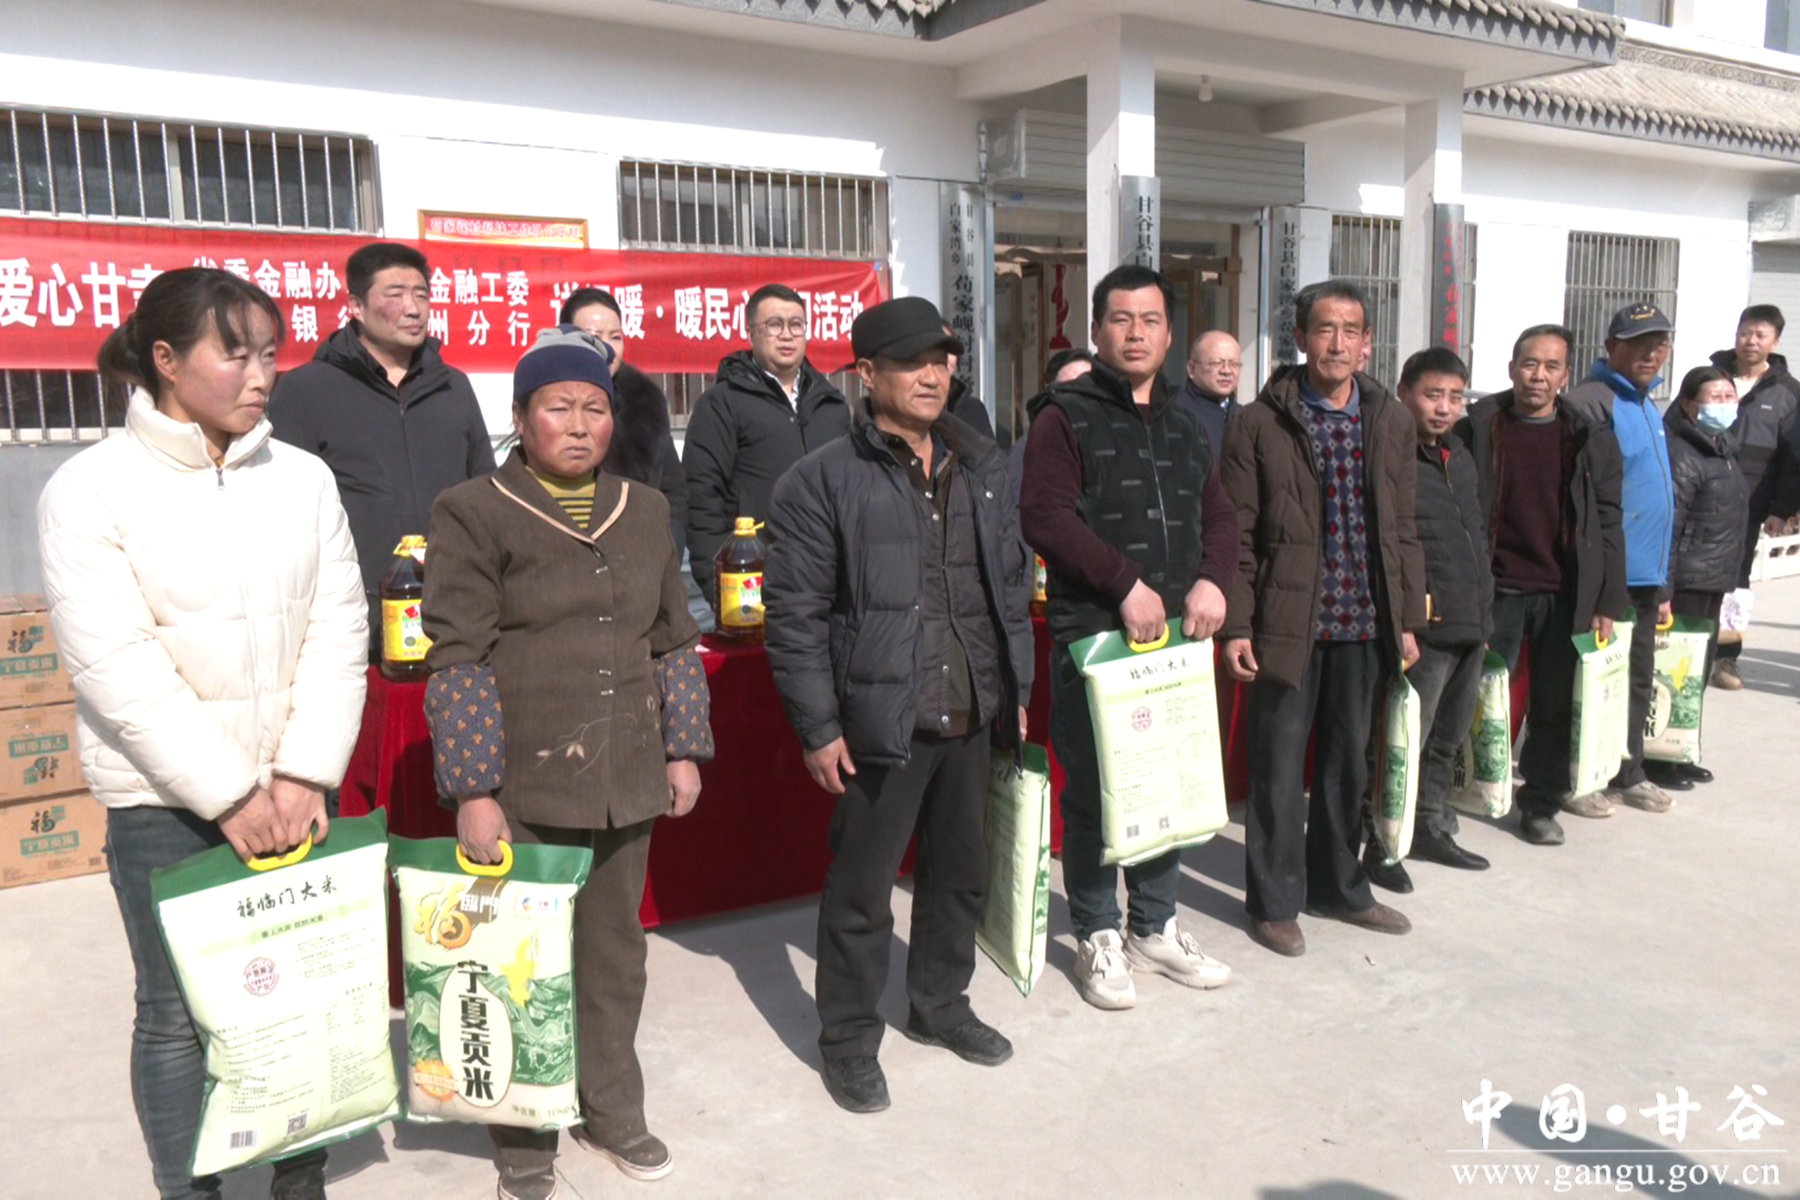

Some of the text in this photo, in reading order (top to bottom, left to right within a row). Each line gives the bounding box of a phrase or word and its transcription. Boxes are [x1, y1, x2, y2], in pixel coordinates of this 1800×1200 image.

[236, 873, 338, 919] 福临门大米
[456, 959, 495, 1101] 宁夏贡米
